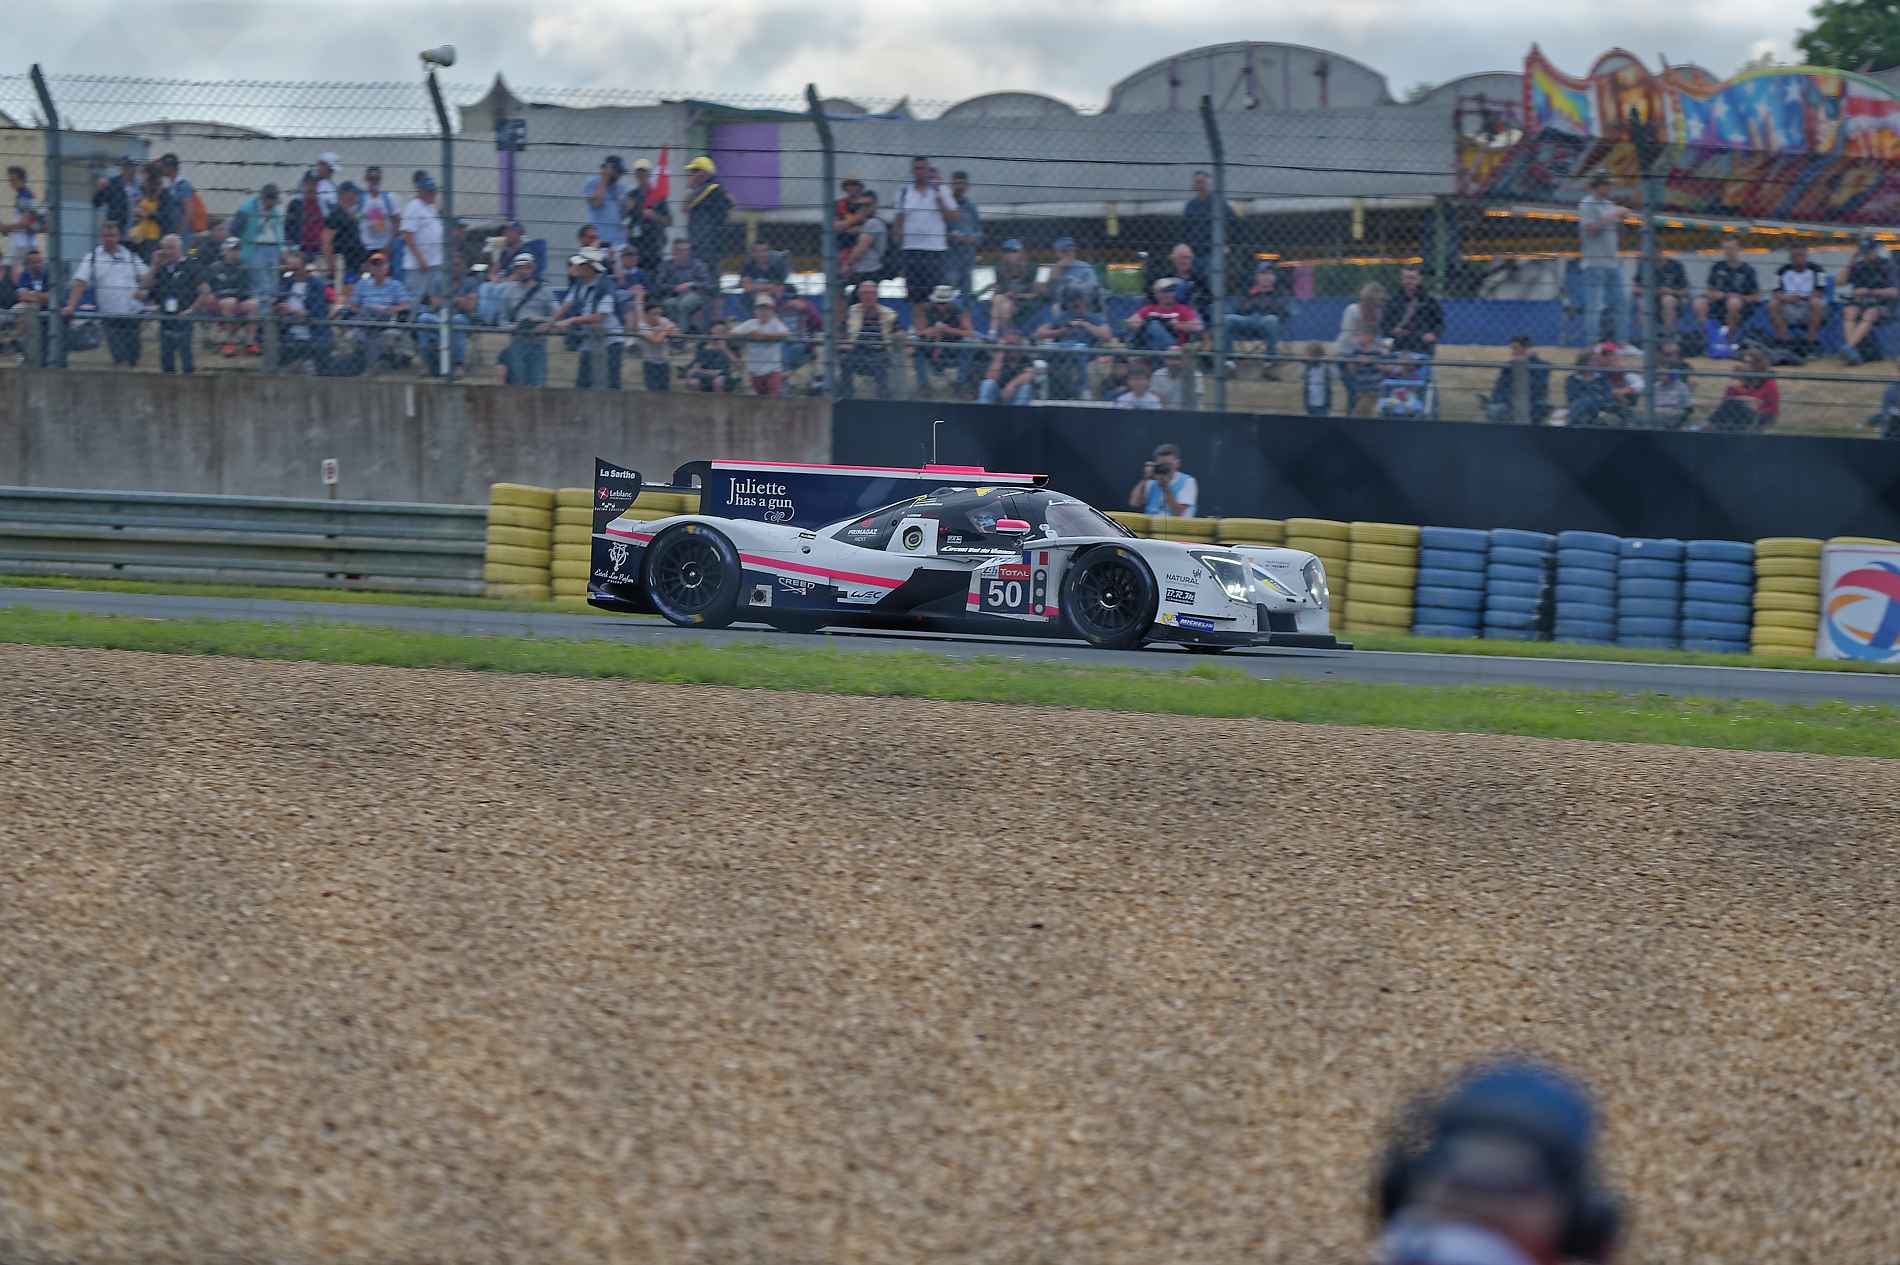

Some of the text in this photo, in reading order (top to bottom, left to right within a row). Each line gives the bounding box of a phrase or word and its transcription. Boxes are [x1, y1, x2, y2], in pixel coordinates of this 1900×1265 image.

[600, 468, 610, 477] La
[609, 489, 633, 498] Leblanc
[726, 477, 786, 505] Juliette
[735, 493, 793, 510] has a gun
[1000, 568, 1030, 577] TOTAL
[778, 577, 815, 589] CREED
[1167, 574, 1199, 585] NATURAL
[850, 590, 883, 599] WEC
[988, 581, 1022, 608] 50
